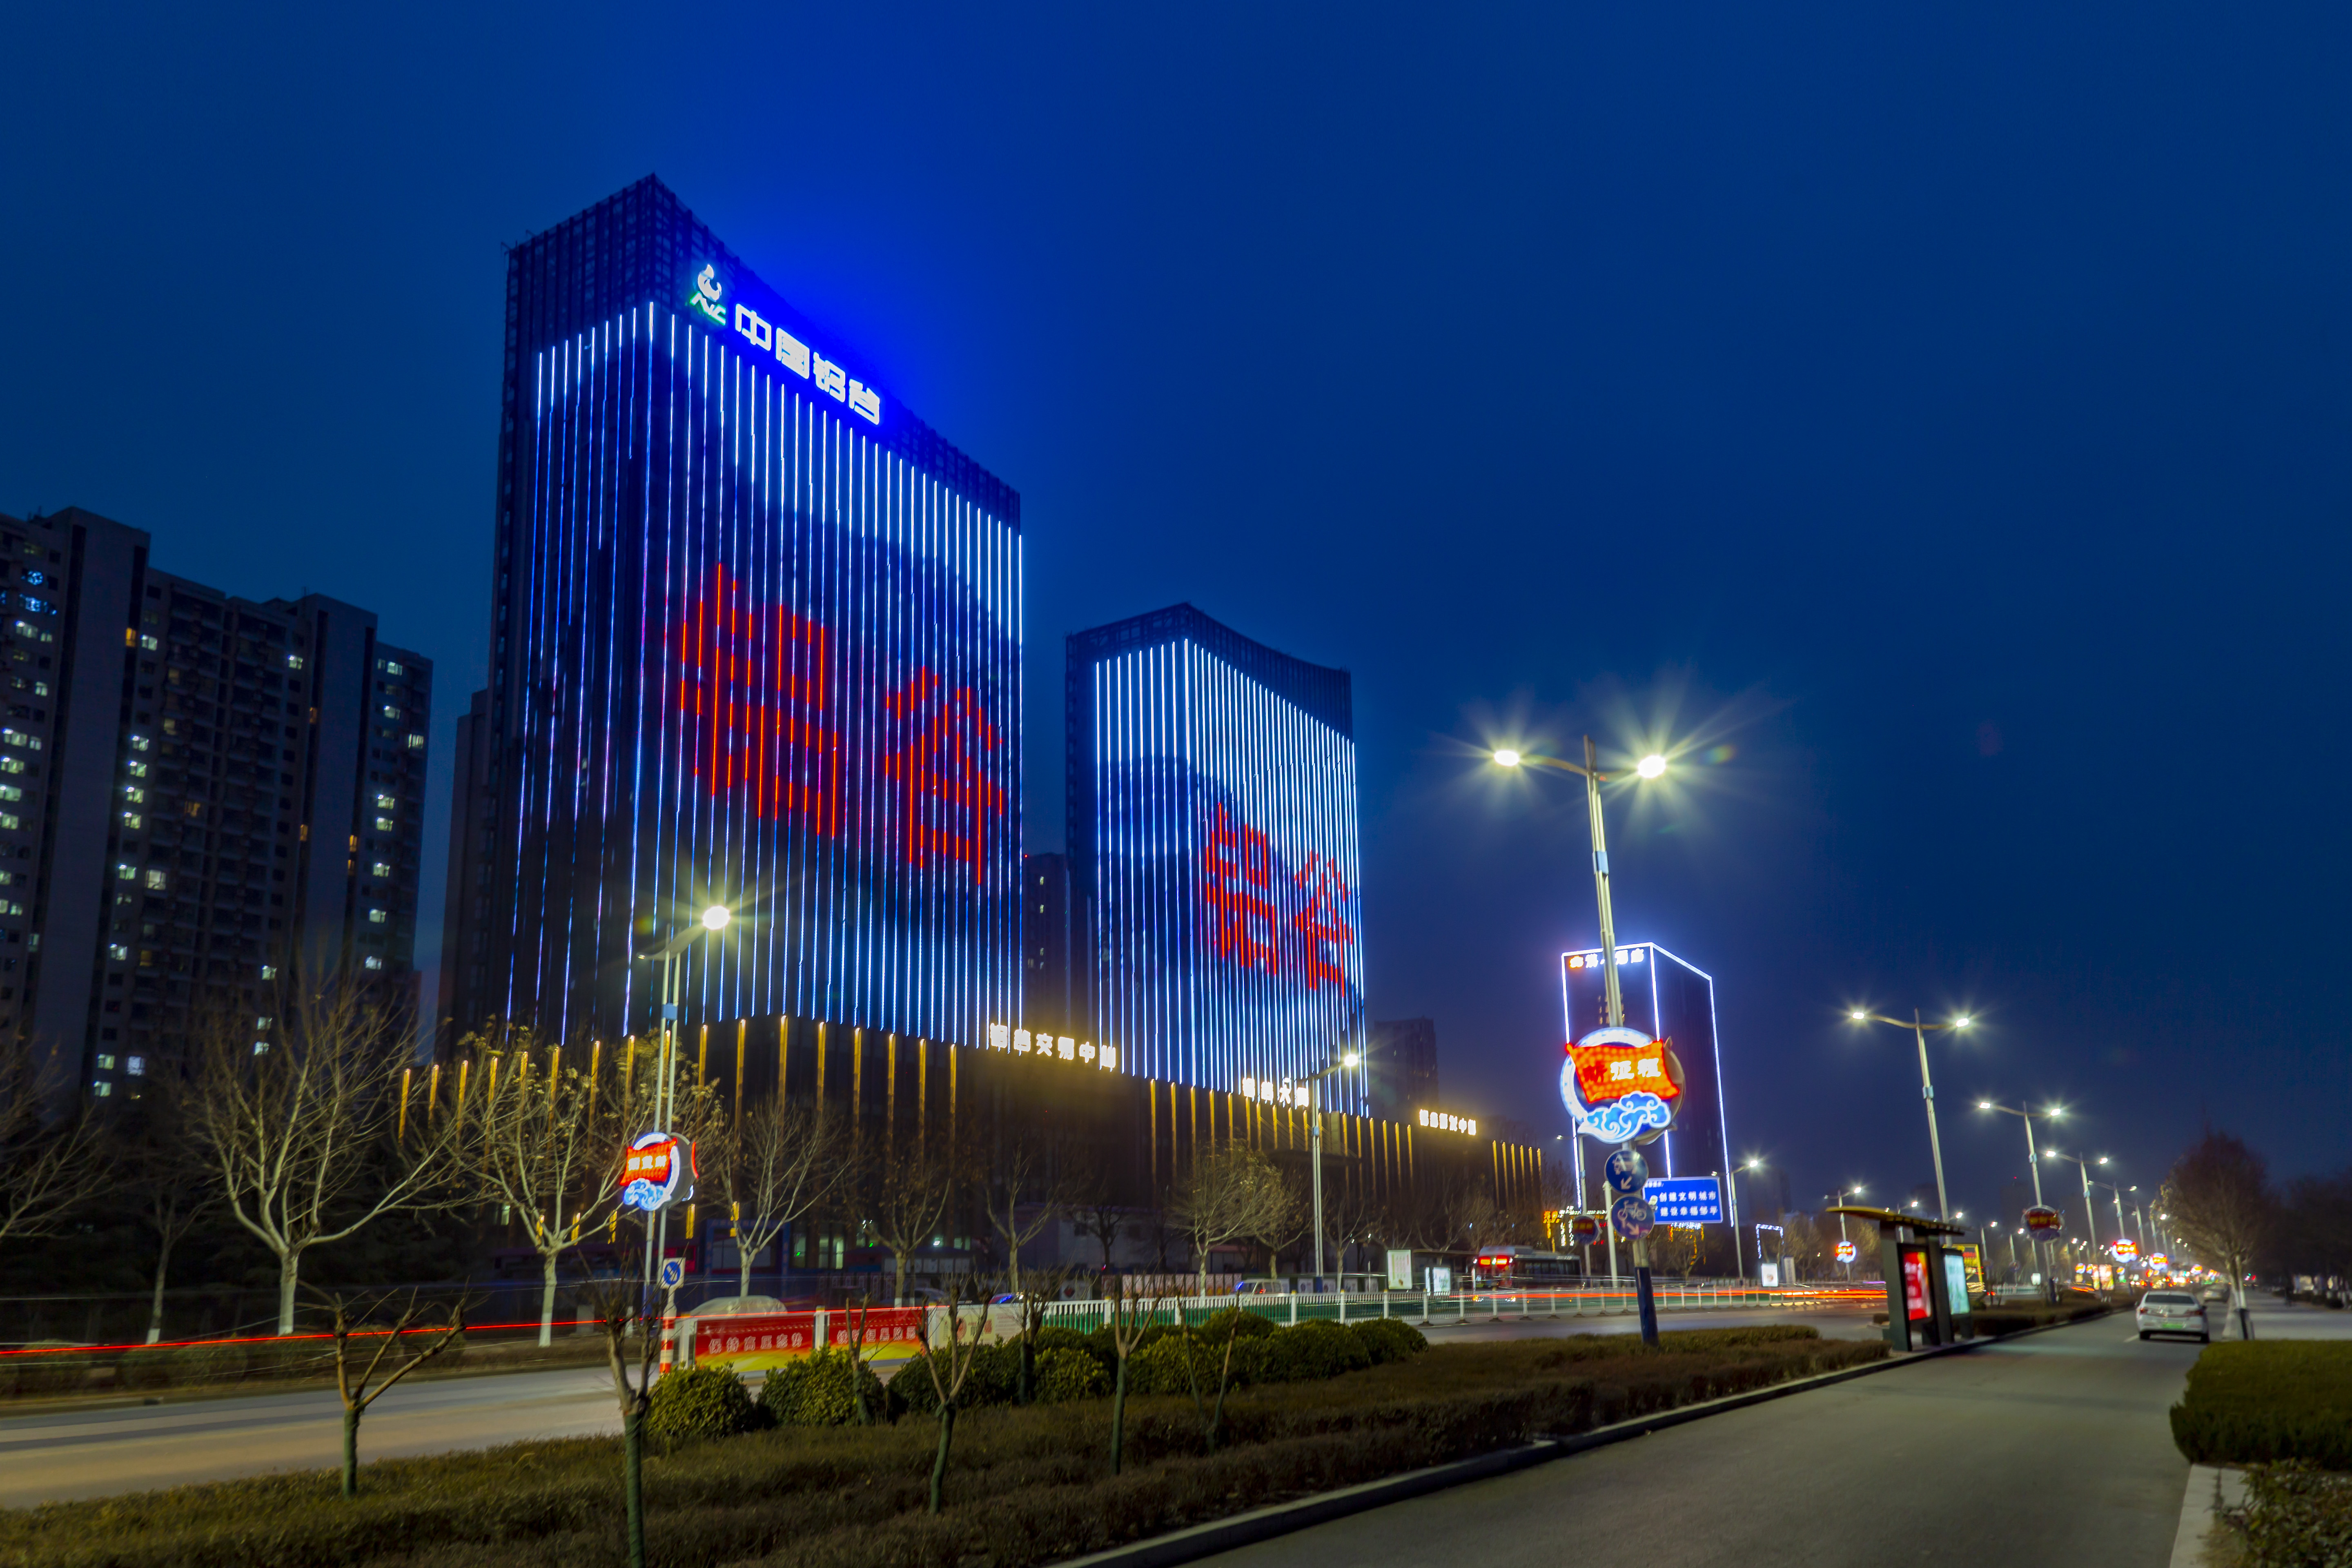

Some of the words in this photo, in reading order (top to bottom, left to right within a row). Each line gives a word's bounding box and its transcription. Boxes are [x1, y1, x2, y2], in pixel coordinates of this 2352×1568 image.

[735, 303, 880, 425] 中国铝谷
[681, 562, 1002, 884] 铝谷
[1206, 802, 1352, 997] 铝谷
[1583, 1058, 1662, 1082] 新征程
[1659, 1190, 1716, 1202] 创建文明城市
